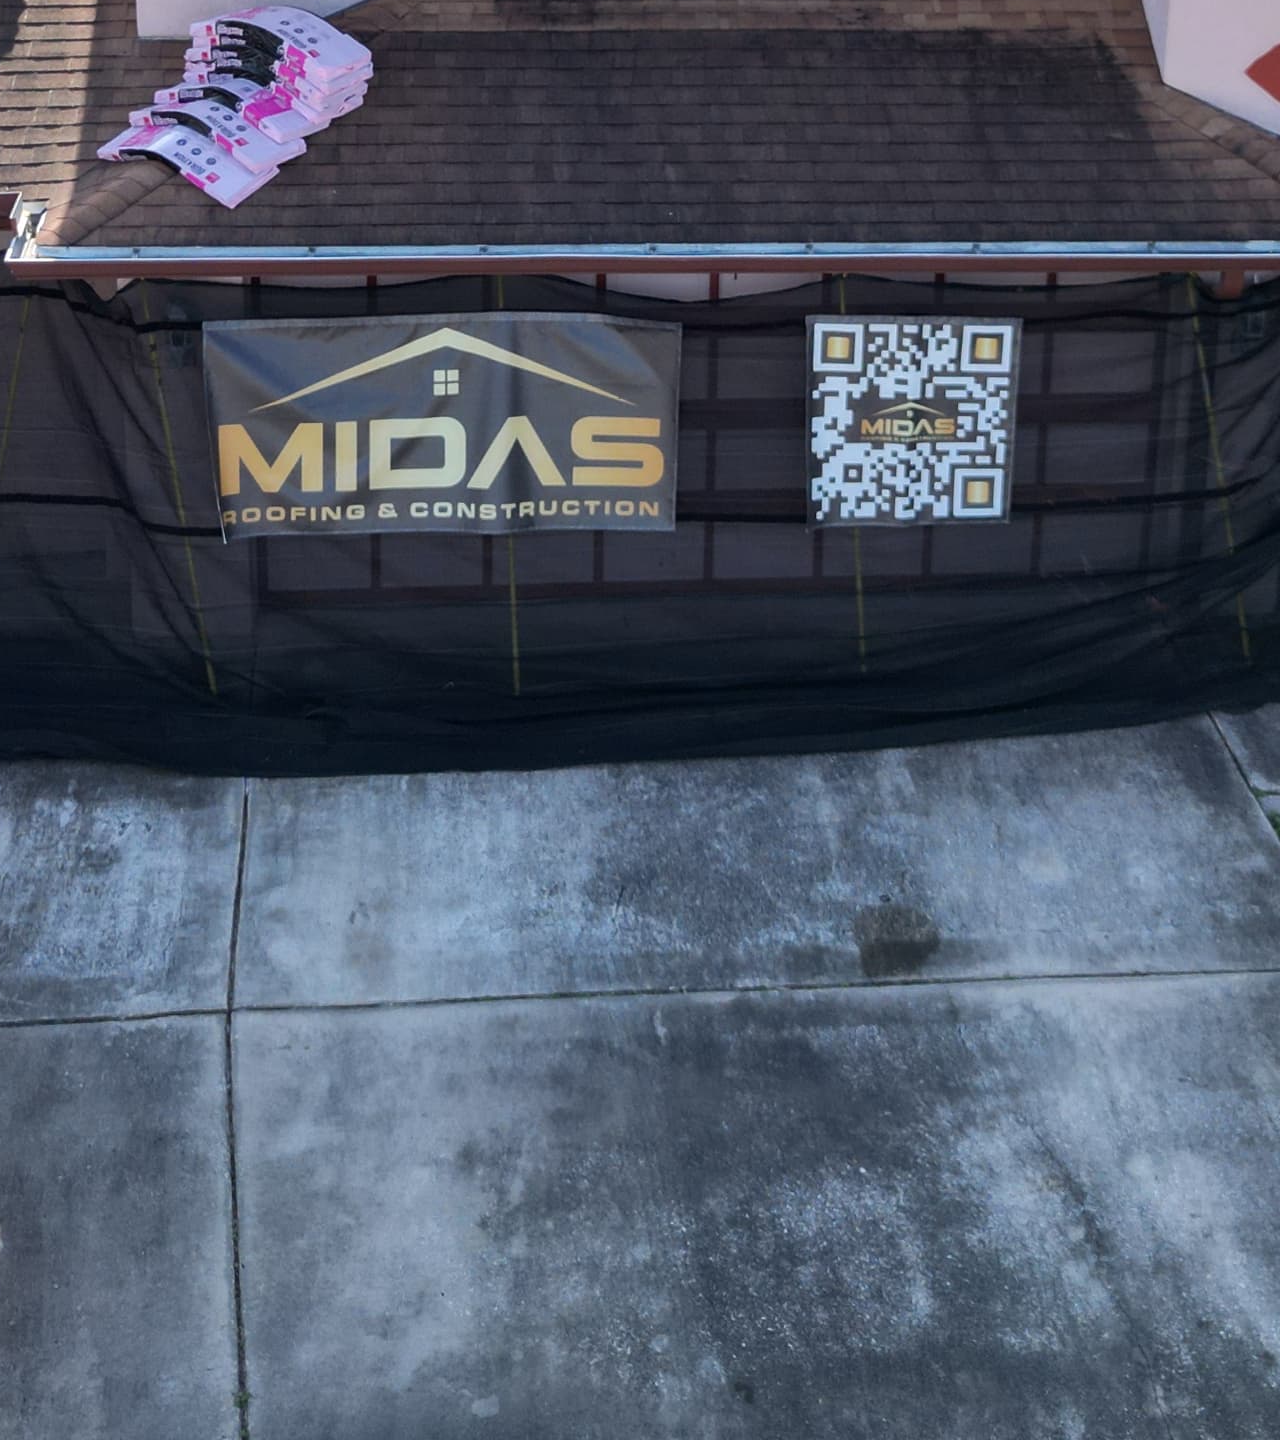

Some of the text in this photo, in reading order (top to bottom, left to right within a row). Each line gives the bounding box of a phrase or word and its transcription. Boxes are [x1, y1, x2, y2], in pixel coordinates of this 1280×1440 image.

[861, 418, 955, 436] MIDAS
[218, 416, 665, 497] MIDAS
[223, 500, 660, 525] ROOFING & CONSTRUCTION
